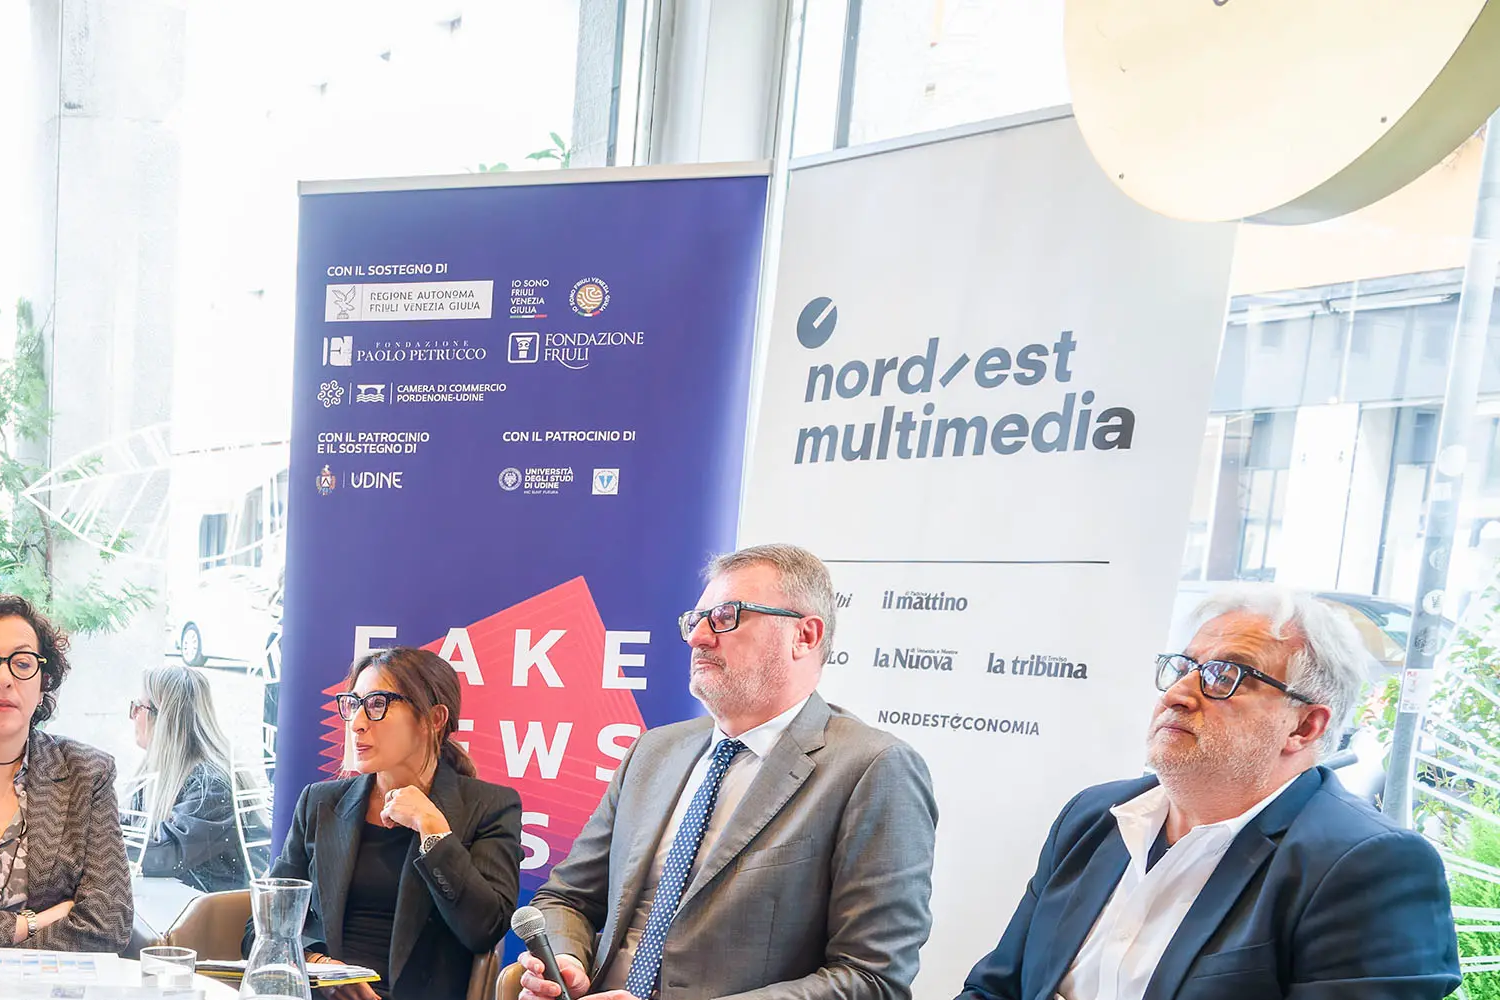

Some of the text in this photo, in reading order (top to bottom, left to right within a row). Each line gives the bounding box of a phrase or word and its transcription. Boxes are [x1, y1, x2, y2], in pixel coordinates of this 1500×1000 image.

[327, 263, 448, 277] CON IL SOSTEGNO DI
[511, 279, 549, 288] IO SONO
[370, 289, 475, 301] REGIONE AUTONOMA
[511, 288, 534, 296] FRIULI
[369, 301, 481, 313] FRIULI VENEZIA GIULIA
[510, 297, 545, 305] VENEZIA
[510, 306, 537, 314] GIULIA
[375, 340, 470, 349] FONDAZIONE
[545, 331, 645, 347] FONDAZIONE
[356, 347, 487, 362] PAOLO PETRUCCO
[544, 347, 590, 368] FRIULI
[396, 383, 507, 393] CAMERA DI COMMERCIO
[396, 393, 484, 402] PORDENONE-UDINE
[794, 390, 1135, 465] multimedia
[317, 432, 430, 443] CON IL PATROCINIO
[502, 430, 636, 442] CON IL PATROCINIO DI
[317, 443, 417, 454] E IL SOSTEGNO DI
[525, 466, 574, 476] UNIVERSITÀ
[351, 471, 403, 489] UDINE
[882, 590, 968, 612] il mattino
[872, 647, 890, 668] la
[892, 648, 953, 671] Nuova
[986, 652, 1088, 680] la tribuna
